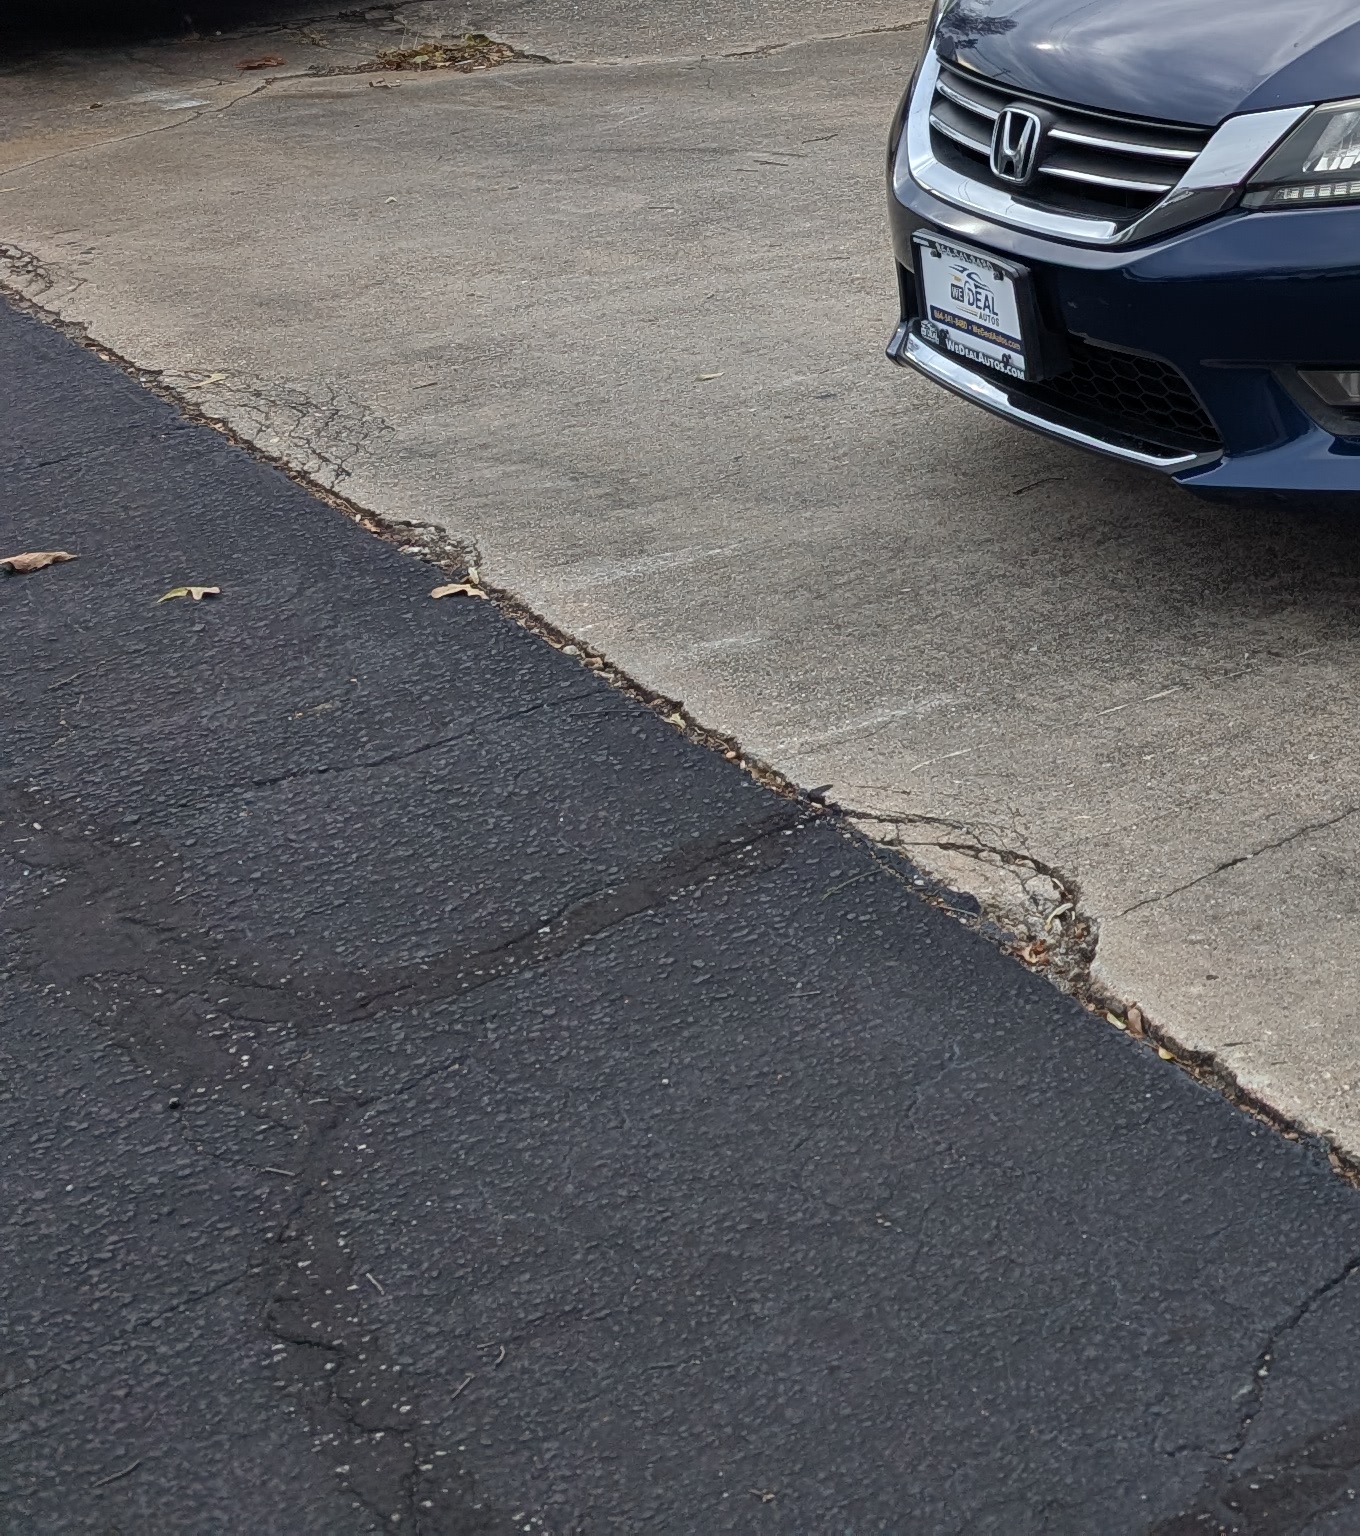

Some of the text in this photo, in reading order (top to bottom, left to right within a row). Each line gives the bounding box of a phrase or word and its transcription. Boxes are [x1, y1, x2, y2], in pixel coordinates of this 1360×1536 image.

[952, 285, 999, 316] WE DEAL
[979, 310, 1000, 327] AUTOS
